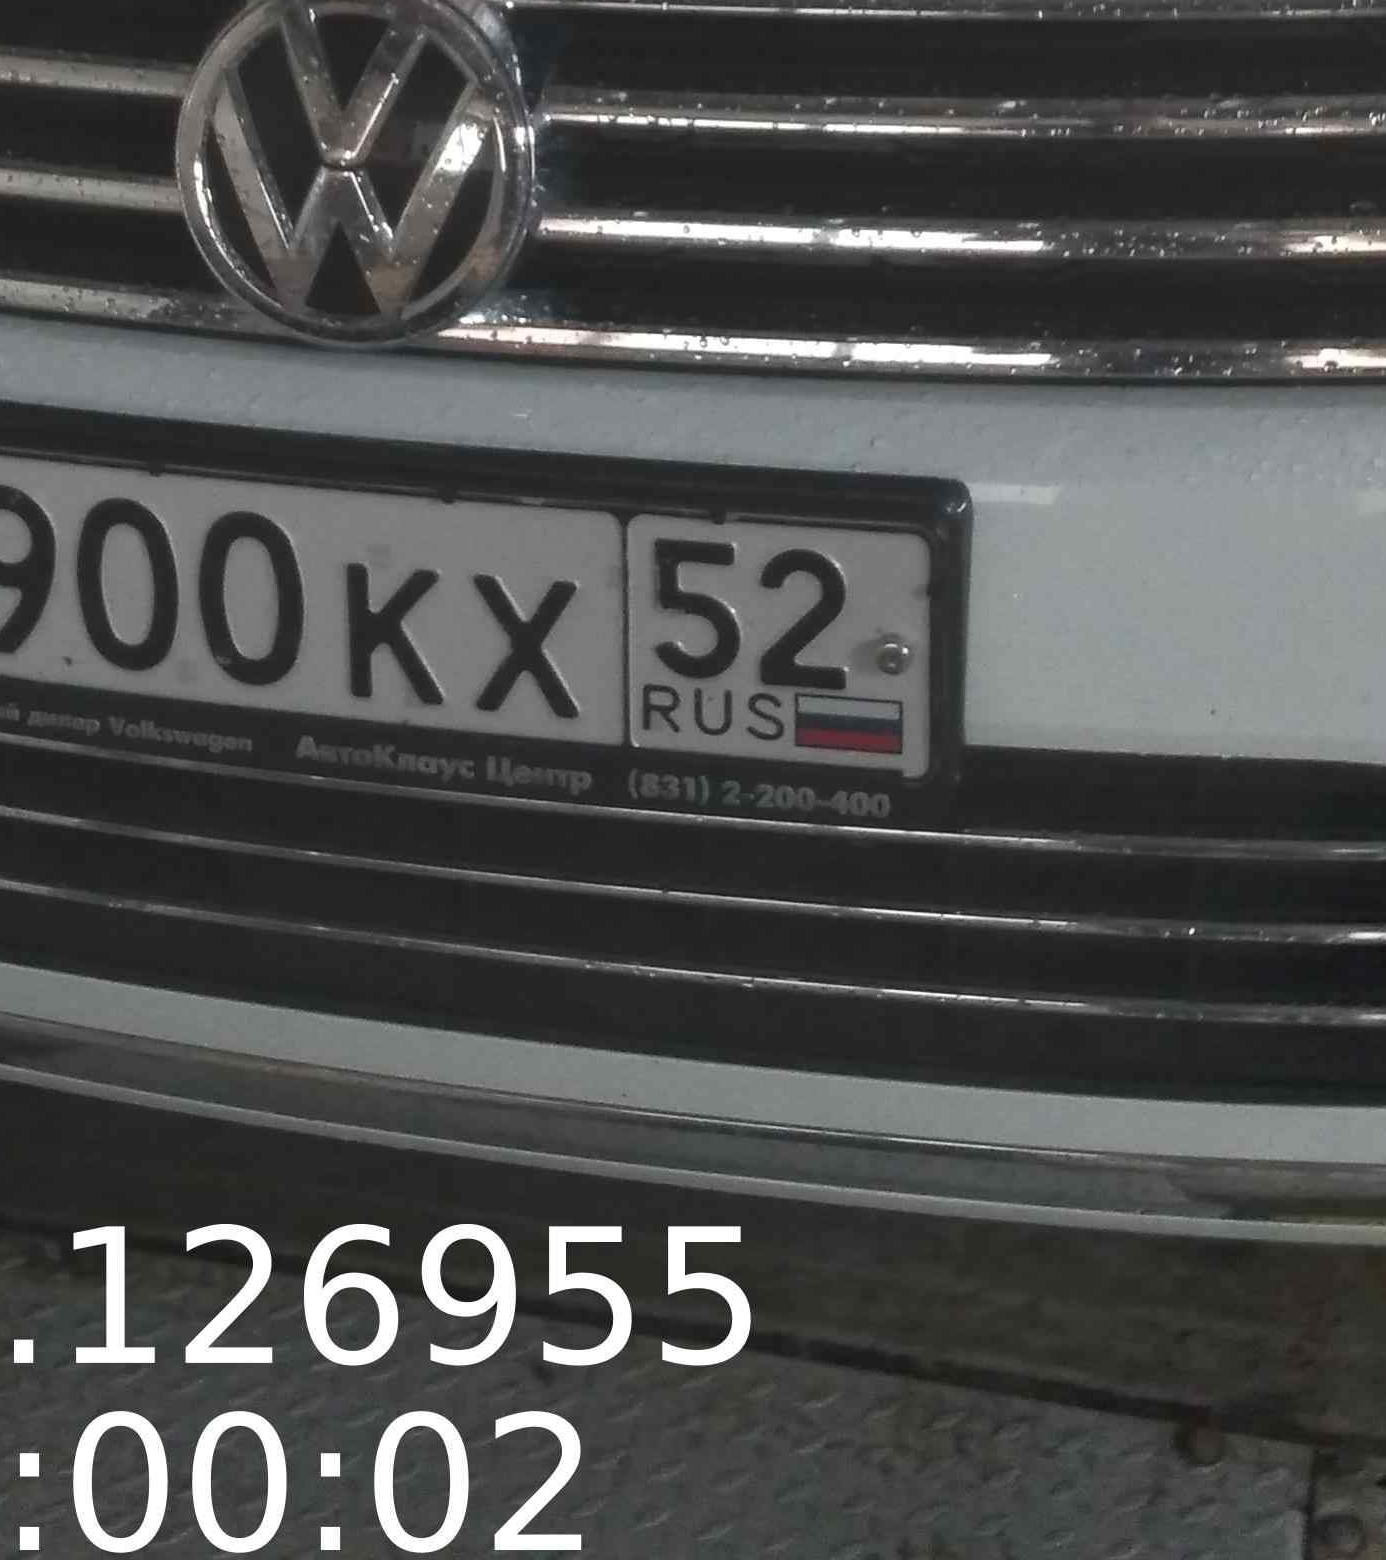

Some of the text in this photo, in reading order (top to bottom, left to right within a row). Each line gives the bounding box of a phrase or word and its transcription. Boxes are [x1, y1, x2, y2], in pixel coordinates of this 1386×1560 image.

[651, 538, 849, 691] 52
[107, 714, 254, 753] Volkswagen
[641, 685, 785, 743] RUS
[485, 754, 594, 797] Центр
[627, 767, 892, 819] (831) 2-200-400
